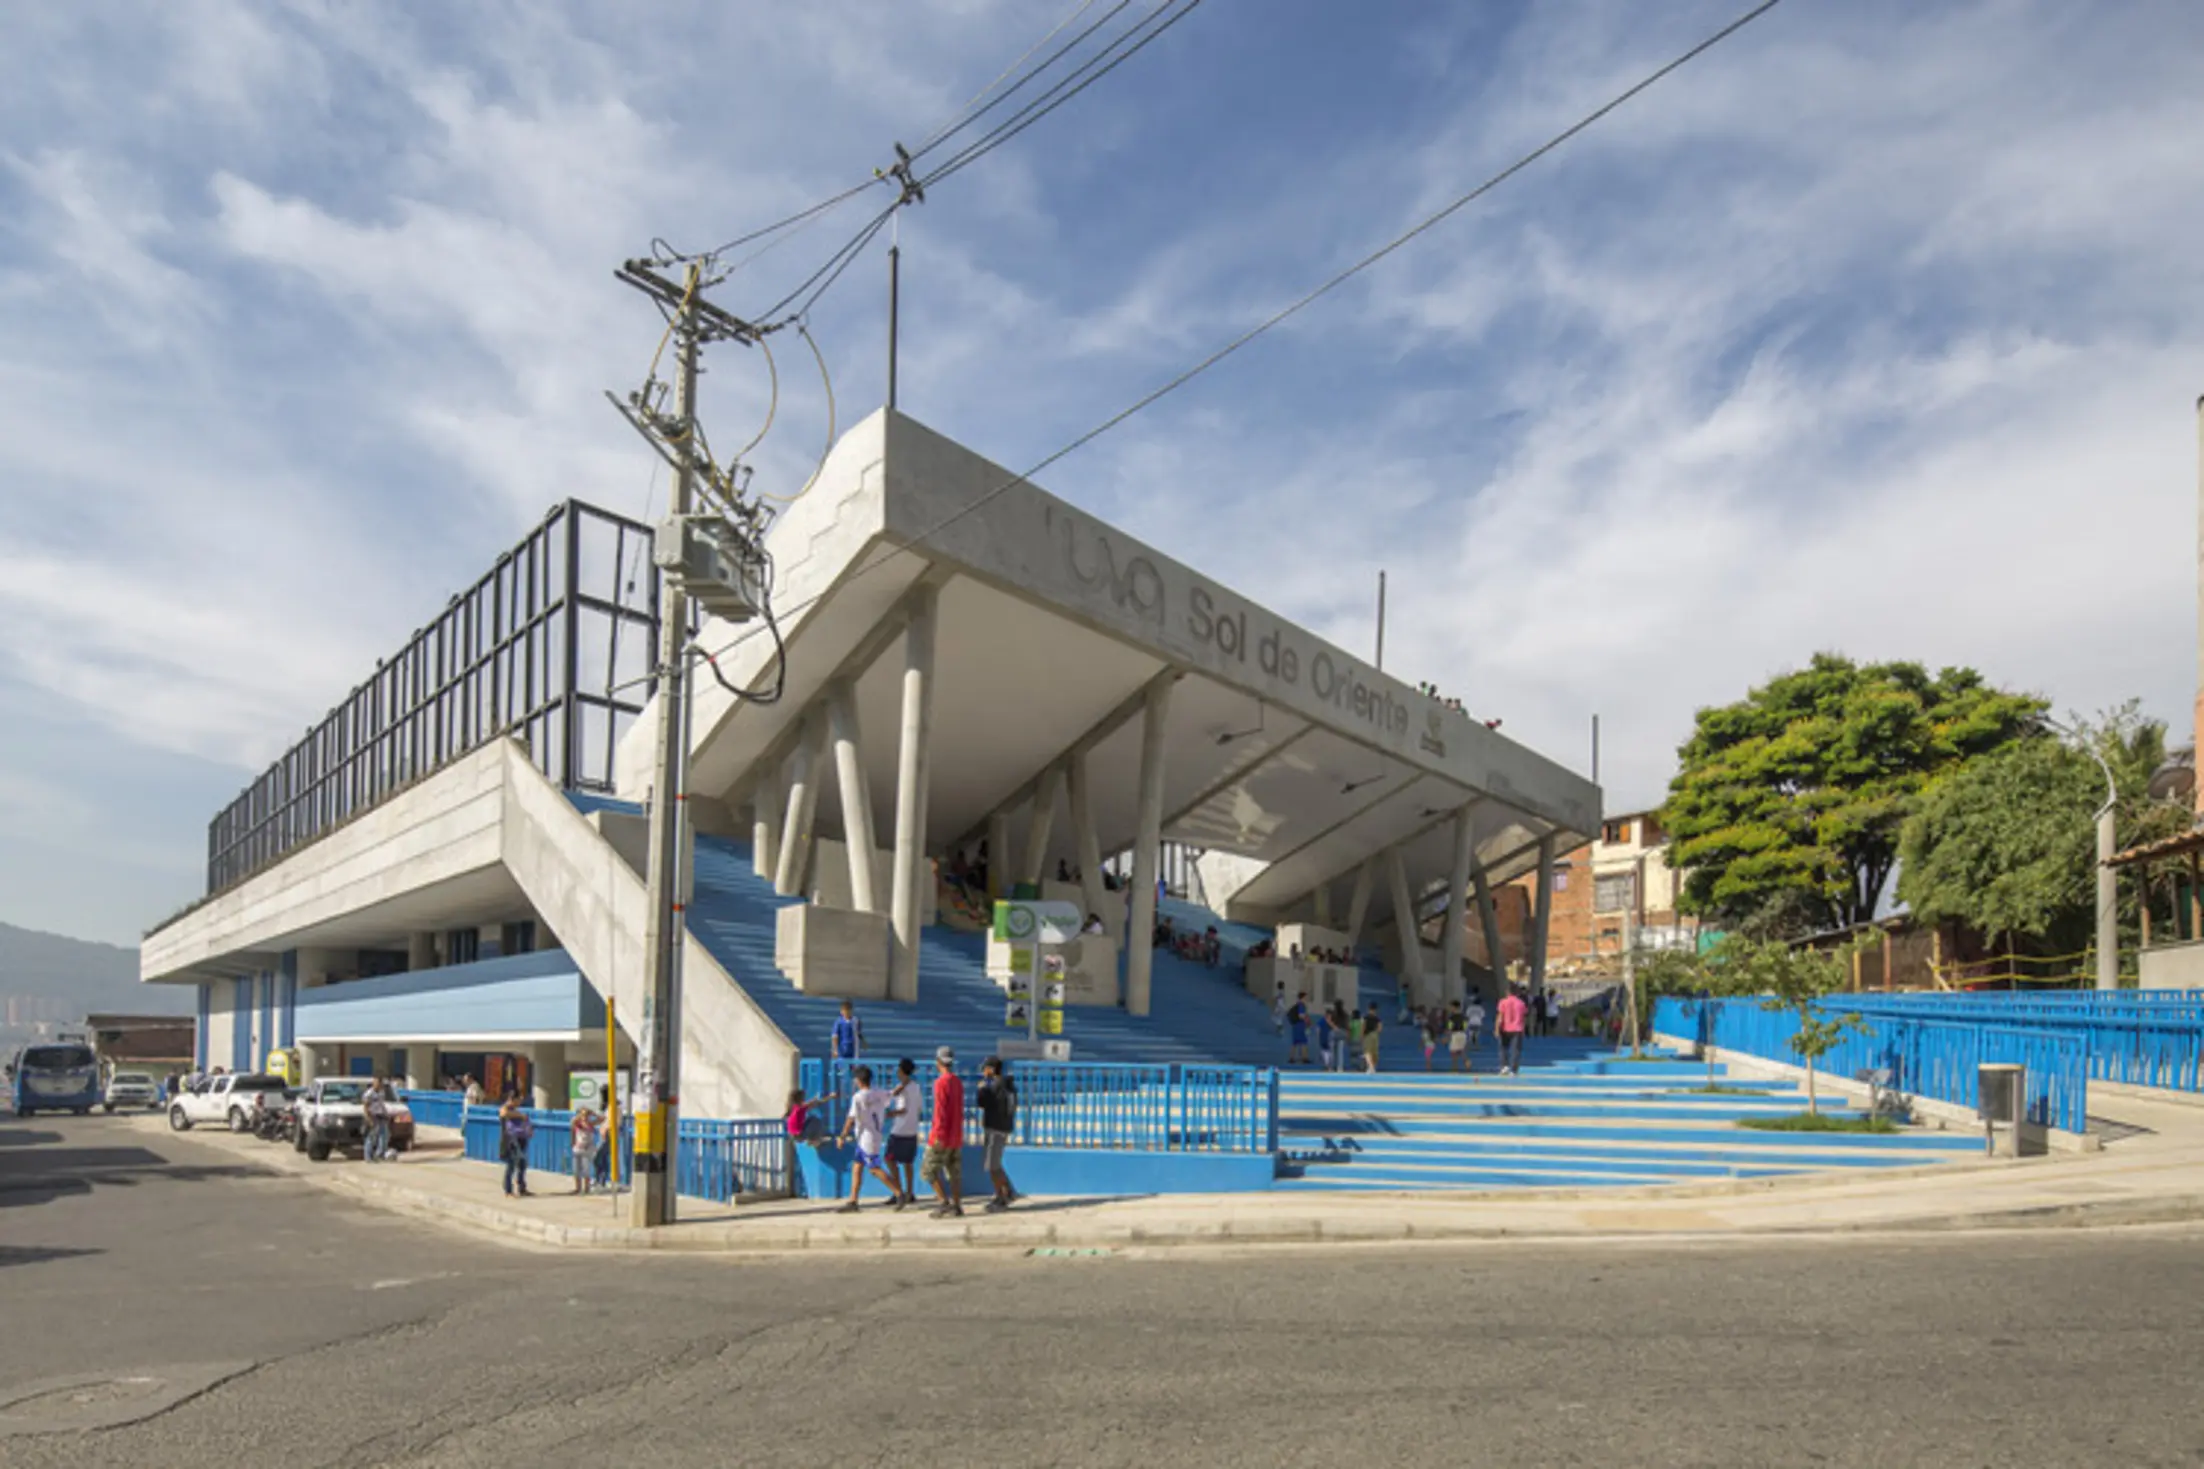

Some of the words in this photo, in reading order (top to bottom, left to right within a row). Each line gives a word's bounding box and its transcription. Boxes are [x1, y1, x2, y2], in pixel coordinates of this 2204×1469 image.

[1188, 586, 1246, 662] Sol
[1259, 631, 1298, 685] de
[1312, 651, 1409, 736] Oriente
